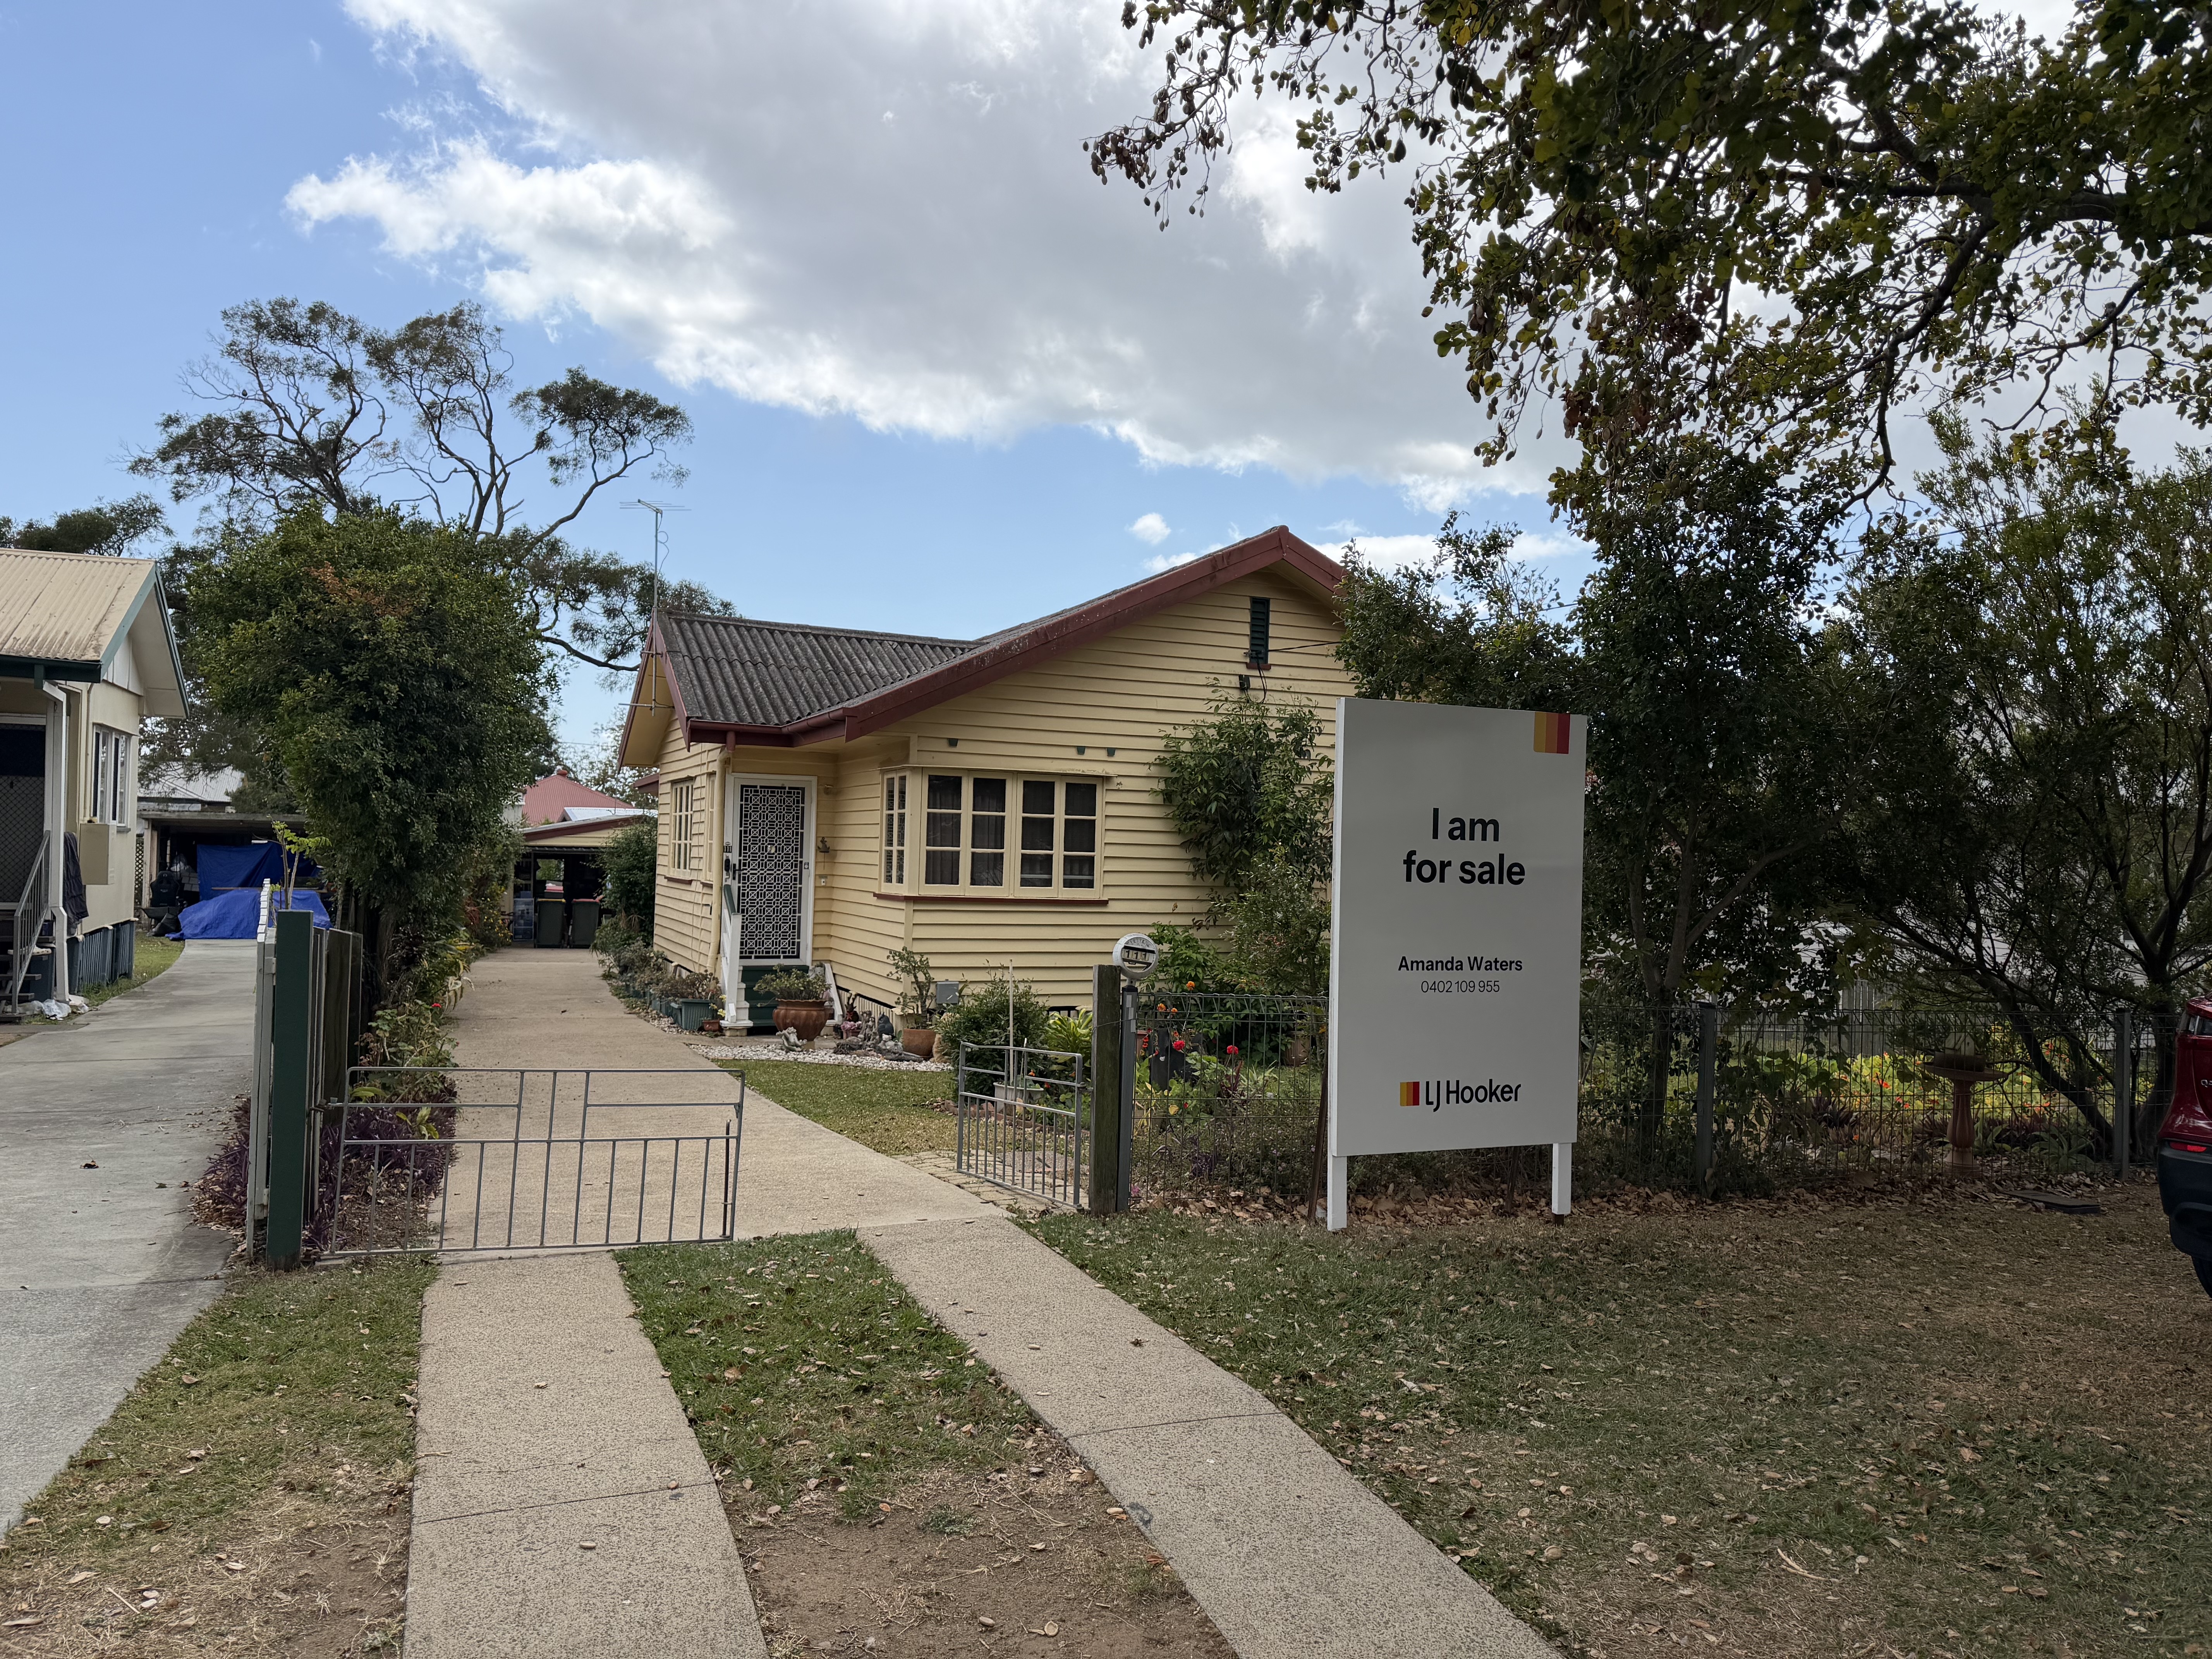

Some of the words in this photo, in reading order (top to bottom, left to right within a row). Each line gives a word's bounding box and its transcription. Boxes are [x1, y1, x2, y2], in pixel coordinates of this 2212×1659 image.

[1432, 807, 1439, 840] I
[1448, 817, 1499, 842] am
[1403, 850, 1452, 883] for
[1458, 853, 1525, 885] sale
[1125, 950, 1147, 960] 111
[1398, 956, 1463, 971] Amanda
[1467, 956, 1523, 971] Waters
[1421, 980, 1453, 993] 0402
[1455, 980, 1475, 993] 109
[1478, 980, 1500, 993] 955
[1425, 1080, 1441, 1113] LJ
[1446, 1079, 1522, 1104] Hooker
